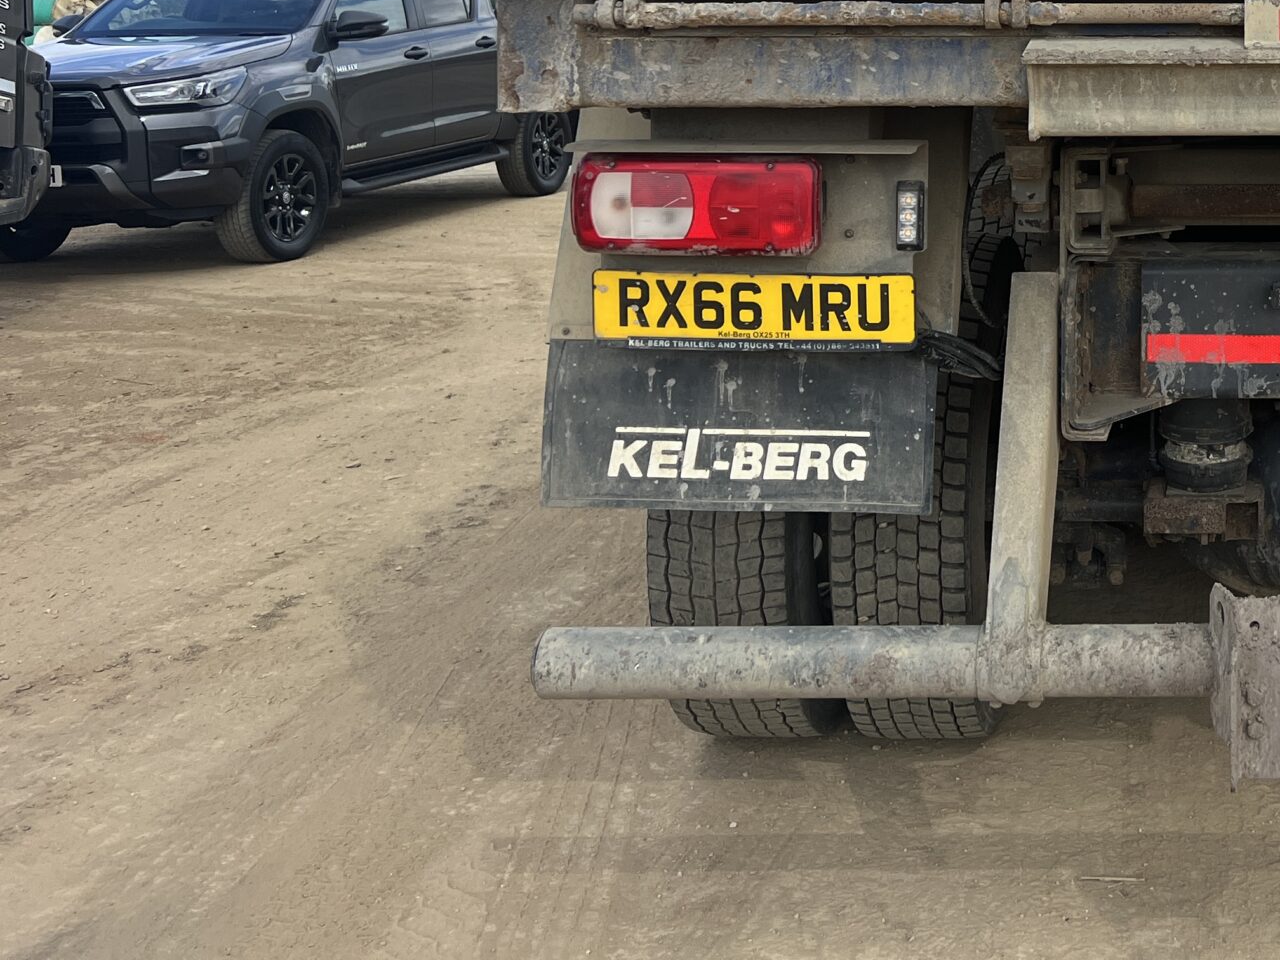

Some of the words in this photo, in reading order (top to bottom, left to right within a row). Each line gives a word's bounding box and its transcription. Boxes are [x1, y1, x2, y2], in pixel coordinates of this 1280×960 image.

[618, 278, 762, 330] RX66
[782, 283, 889, 332] MRU
[647, 339, 671, 348] BERG
[672, 340, 716, 349] TRAILERS
[718, 340, 736, 349] AND
[739, 341, 775, 350] TRUCKS
[777, 342, 795, 350] TEL
[718, 331, 751, 339] Kel-Berg
[753, 331, 773, 339] OX25
[775, 331, 790, 339] 3TH
[608, 428, 868, 482] KEL-BERG
